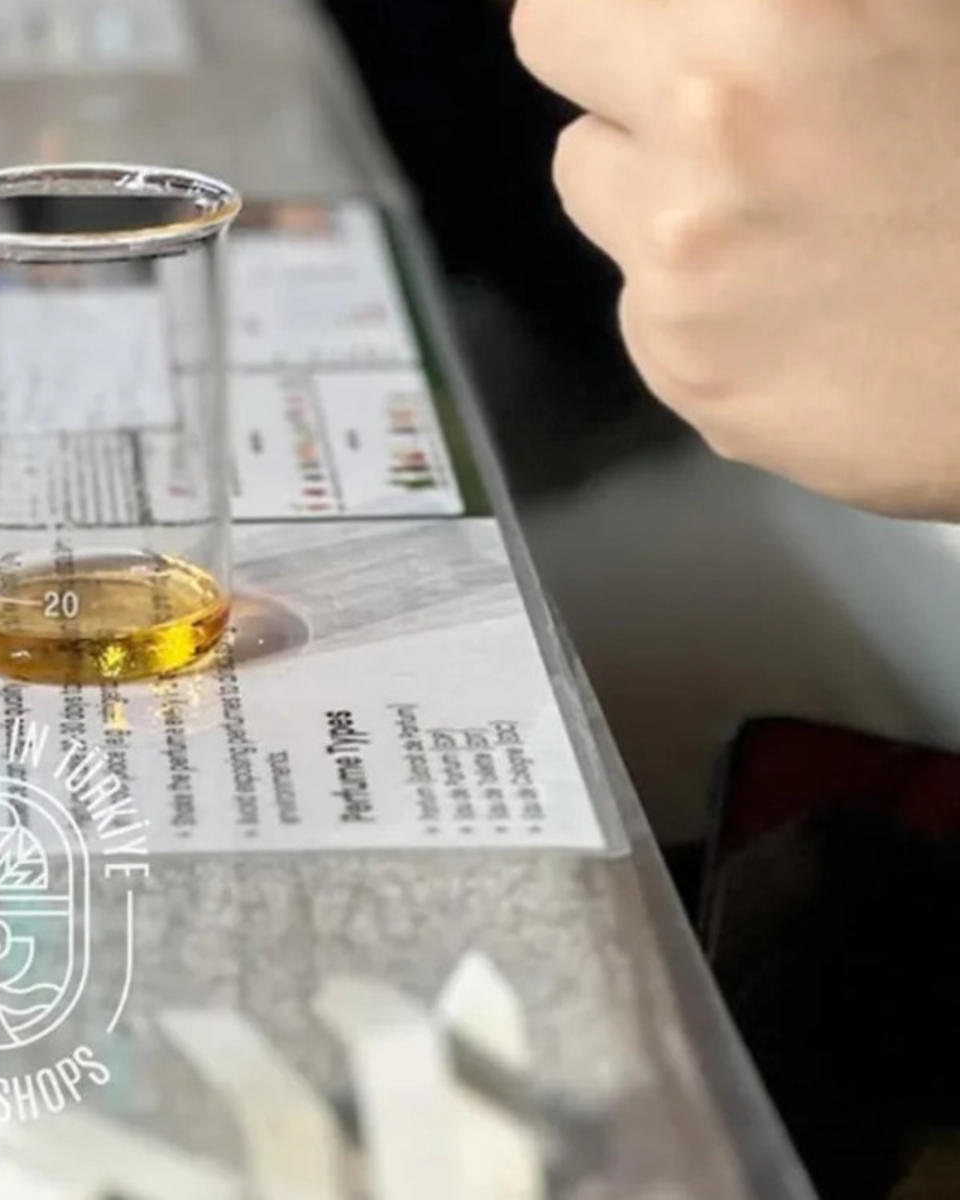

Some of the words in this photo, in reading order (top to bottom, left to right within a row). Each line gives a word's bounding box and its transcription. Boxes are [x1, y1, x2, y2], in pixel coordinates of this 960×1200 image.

[44, 591, 78, 617] 20
[61, 697, 90, 719] days
[218, 697, 256, 745] perfumes
[385, 703, 419, 739] Parfum)
[326, 711, 370, 754] Types
[403, 740, 423, 752] de
[160, 728, 197, 771] perfume
[225, 747, 259, 793] exposing
[441, 754, 465, 786] Parfum
[506, 748, 535, 785] Cologne
[166, 775, 192, 791] the
[330, 756, 376, 823] Perfume
[450, 788, 471, 799] de
[484, 788, 503, 799] de
[517, 788, 537, 799] de
[168, 794, 196, 827] Shake
[229, 796, 260, 825] Avoid
[416, 787, 440, 820] Parfum
[453, 801, 476, 820] Eau
[487, 801, 510, 820] Eau
[520, 801, 544, 820] Eau
